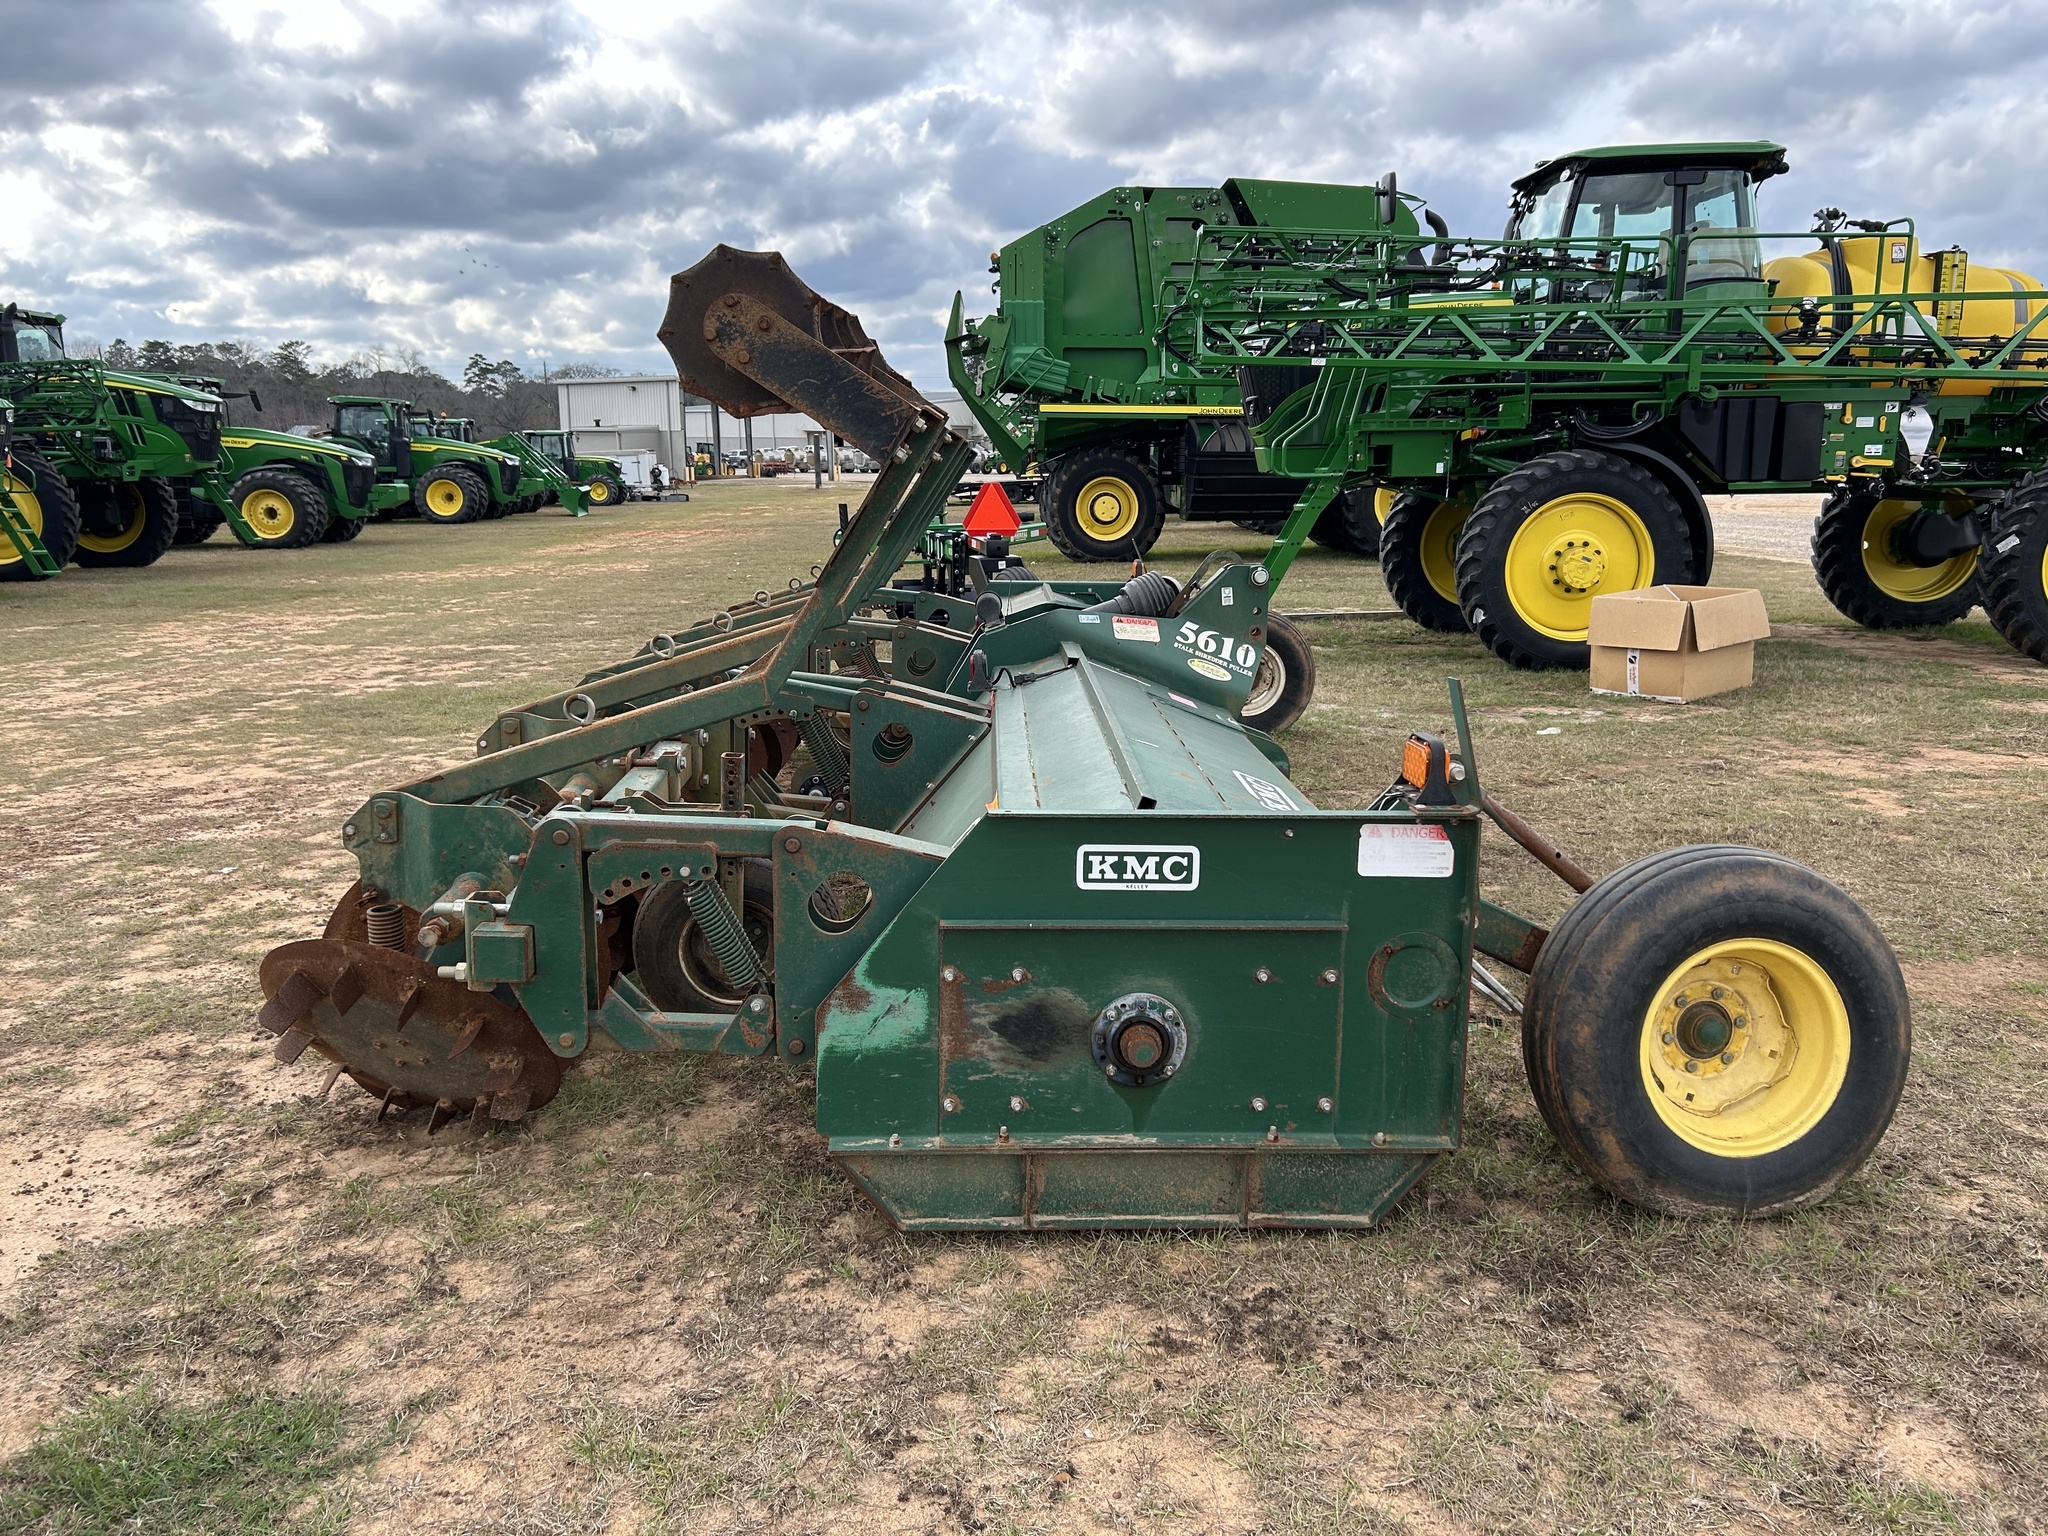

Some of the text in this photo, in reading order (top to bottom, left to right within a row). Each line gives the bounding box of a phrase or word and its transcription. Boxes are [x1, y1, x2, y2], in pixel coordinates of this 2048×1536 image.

[1126, 618, 1153, 626] DANGER
[1175, 620, 1256, 668] 5610
[1173, 641, 1195, 655] STALK
[1194, 650, 1228, 668] SHREDDER
[1228, 662, 1253, 678] PULLER
[1391, 827, 1446, 839] DANGER
[1087, 855, 1189, 881] KMC
